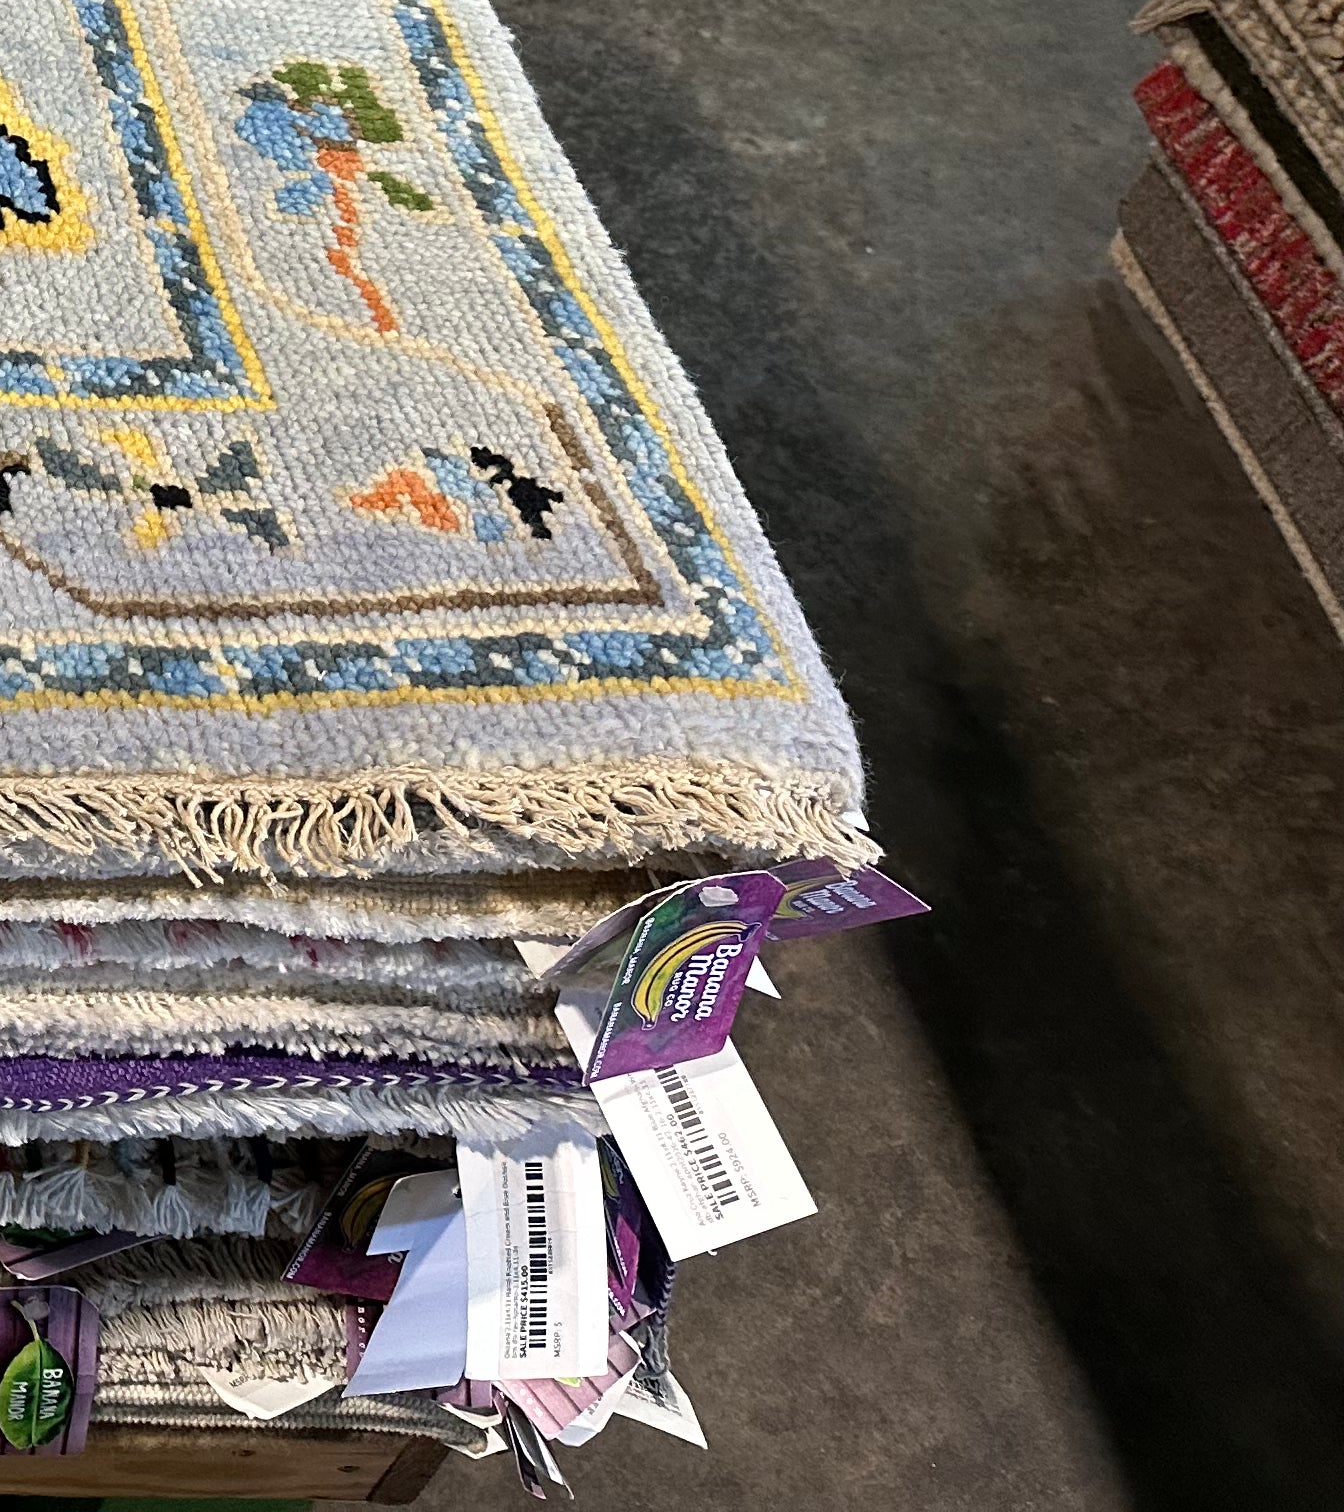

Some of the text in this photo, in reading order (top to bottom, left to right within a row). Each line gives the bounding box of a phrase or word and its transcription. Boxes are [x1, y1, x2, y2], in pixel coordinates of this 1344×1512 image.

[670, 953, 714, 1022] Manor
[694, 943, 743, 1021] Banana
[688, 1158, 709, 1191] PRICE
[740, 1173, 761, 1207] MSRP:
[706, 1191, 724, 1220] SALE
[520, 1265, 528, 1303] $415.00
[519, 1335, 527, 1359] SALE
[8, 1381, 28, 1421] MANOR
[39, 1368, 64, 1419] BANANA
